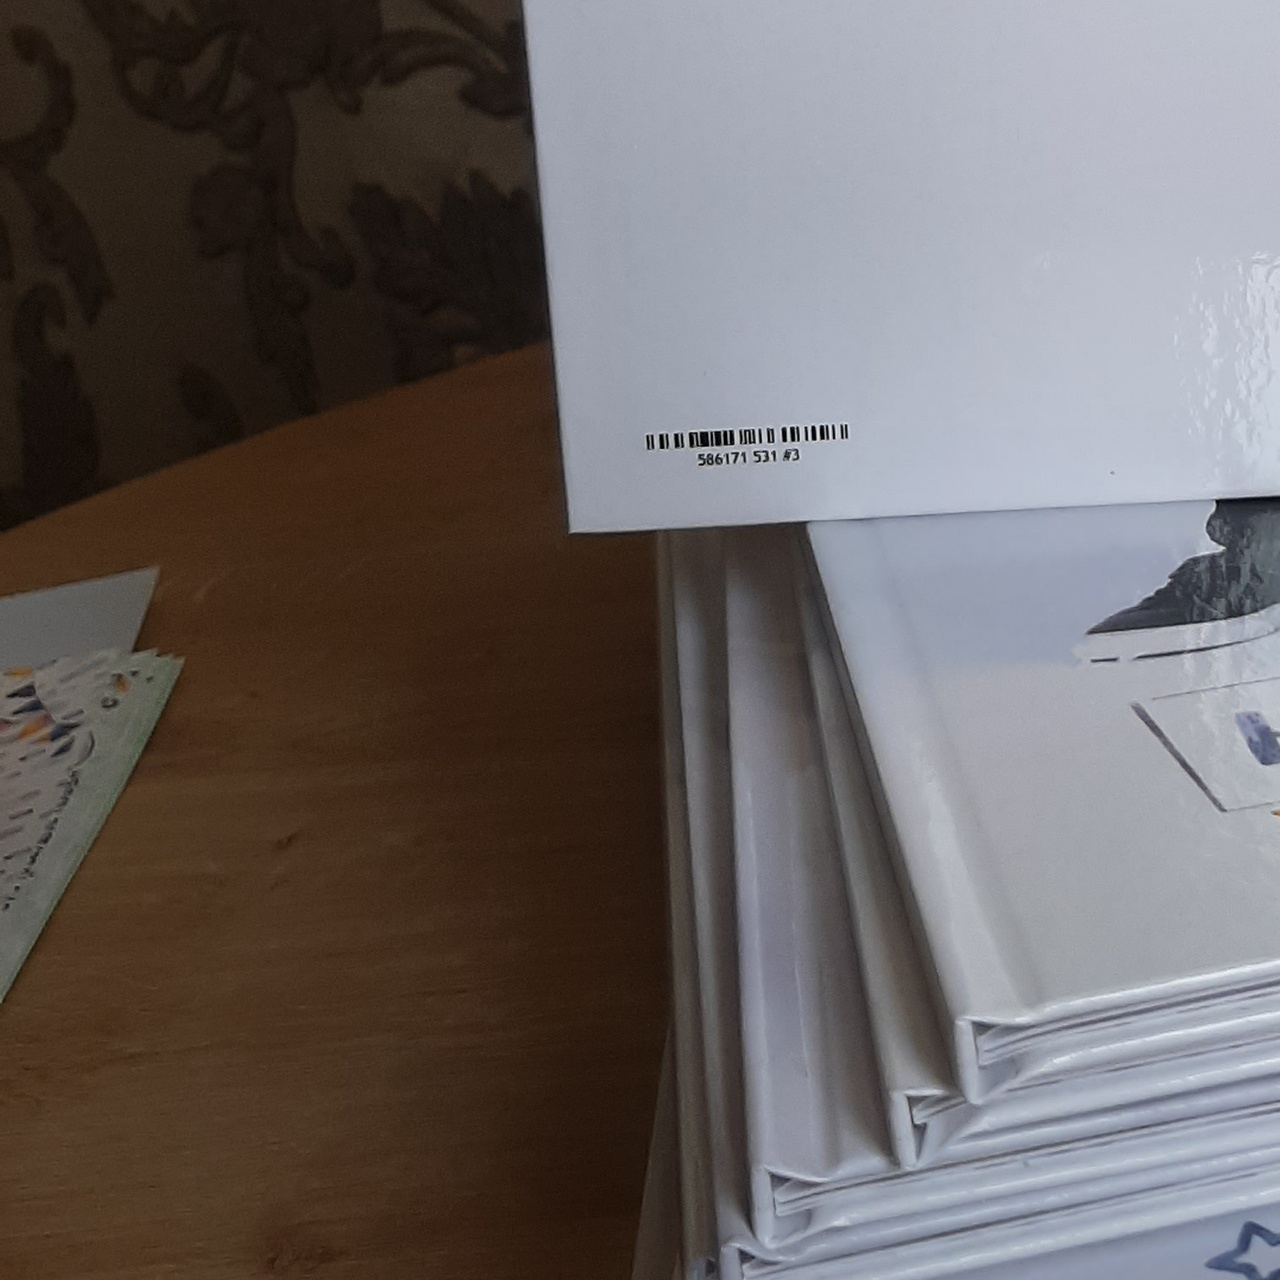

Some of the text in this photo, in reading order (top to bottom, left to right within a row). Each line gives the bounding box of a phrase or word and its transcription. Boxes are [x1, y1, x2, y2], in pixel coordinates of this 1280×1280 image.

[697, 448, 800, 466] 586171 531 #3
